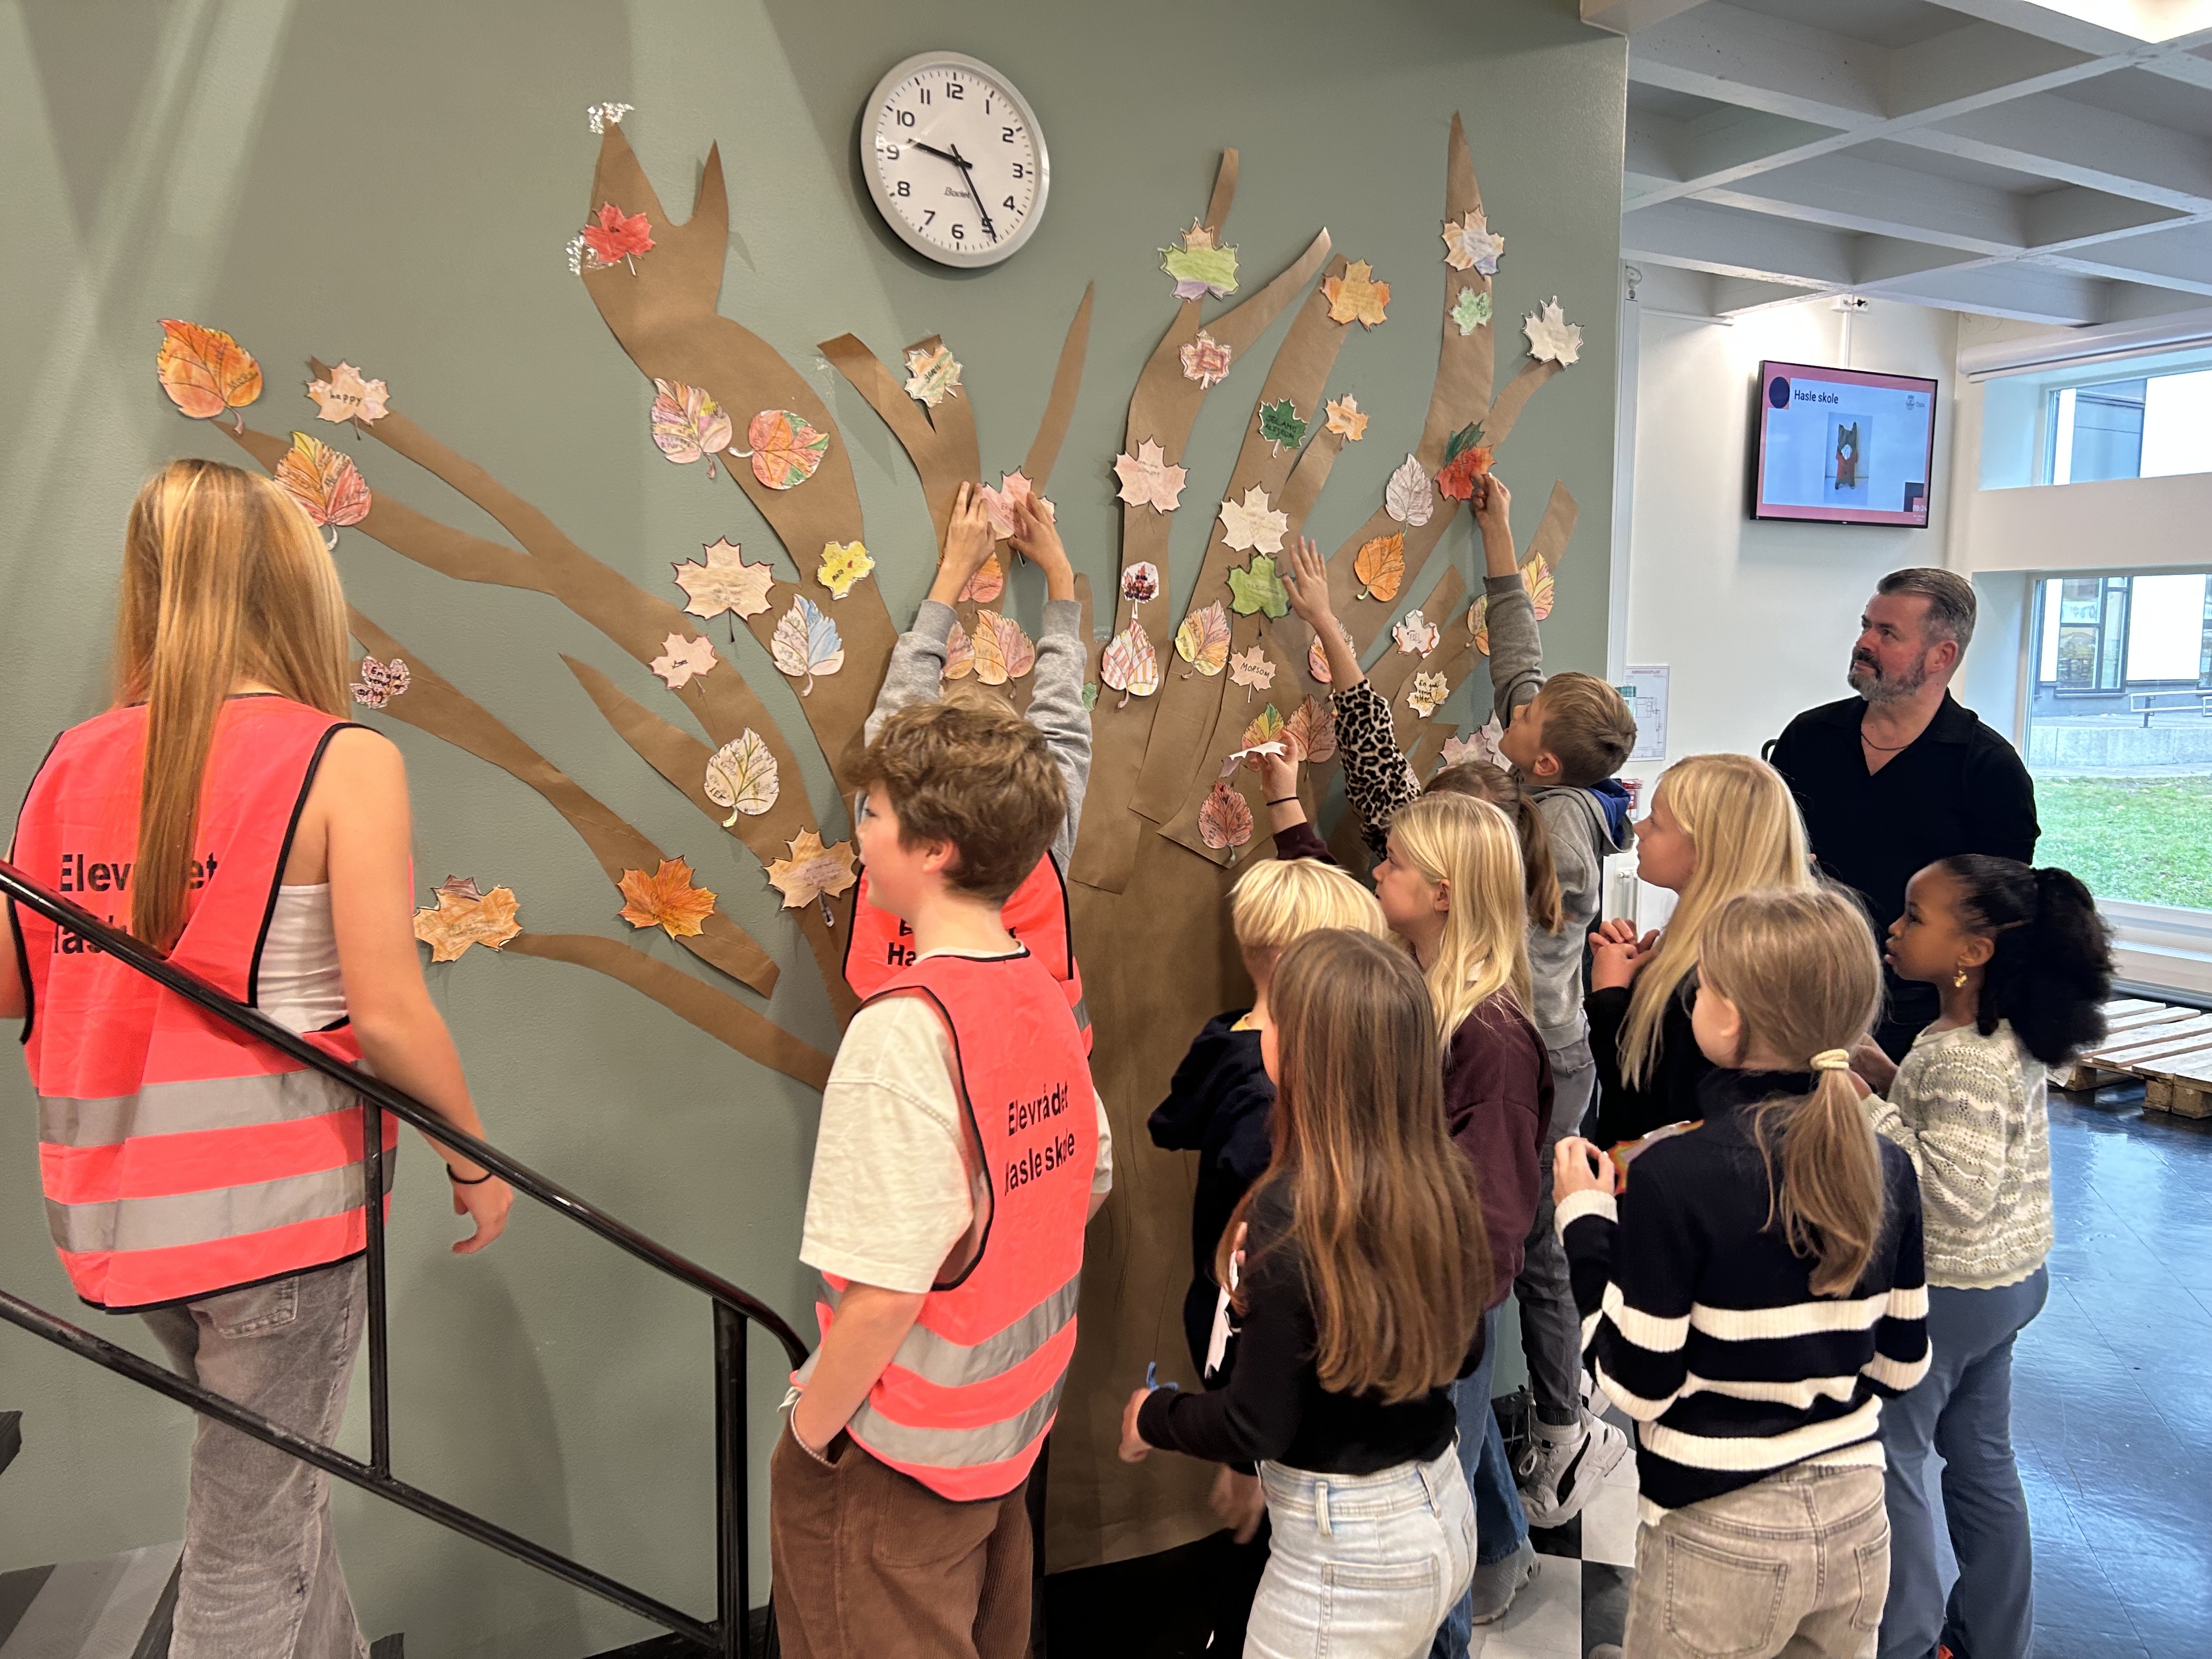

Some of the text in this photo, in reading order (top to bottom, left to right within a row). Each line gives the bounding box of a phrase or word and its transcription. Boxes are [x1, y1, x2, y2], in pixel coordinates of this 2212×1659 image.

[921, 88, 931, 105] 11
[946, 82, 963, 100] 12
[986, 99, 990, 115] 1
[896, 110, 915, 127] 10
[1002, 127, 1014, 143] 2
[887, 144, 900, 160] 9
[1013, 163, 1023, 178] 3
[897, 181, 911, 197] 8
[1003, 196, 1015, 210] 4
[923, 210, 935, 225] 7
[951, 224, 964, 240] 6
[981, 218, 993, 234] 5
[1794, 390, 1839, 404] Hasle skole
[1240, 662, 1270, 679] MORSOM
[60, 852, 218, 891] Elevet
[1045, 1127, 1075, 1171] ske
